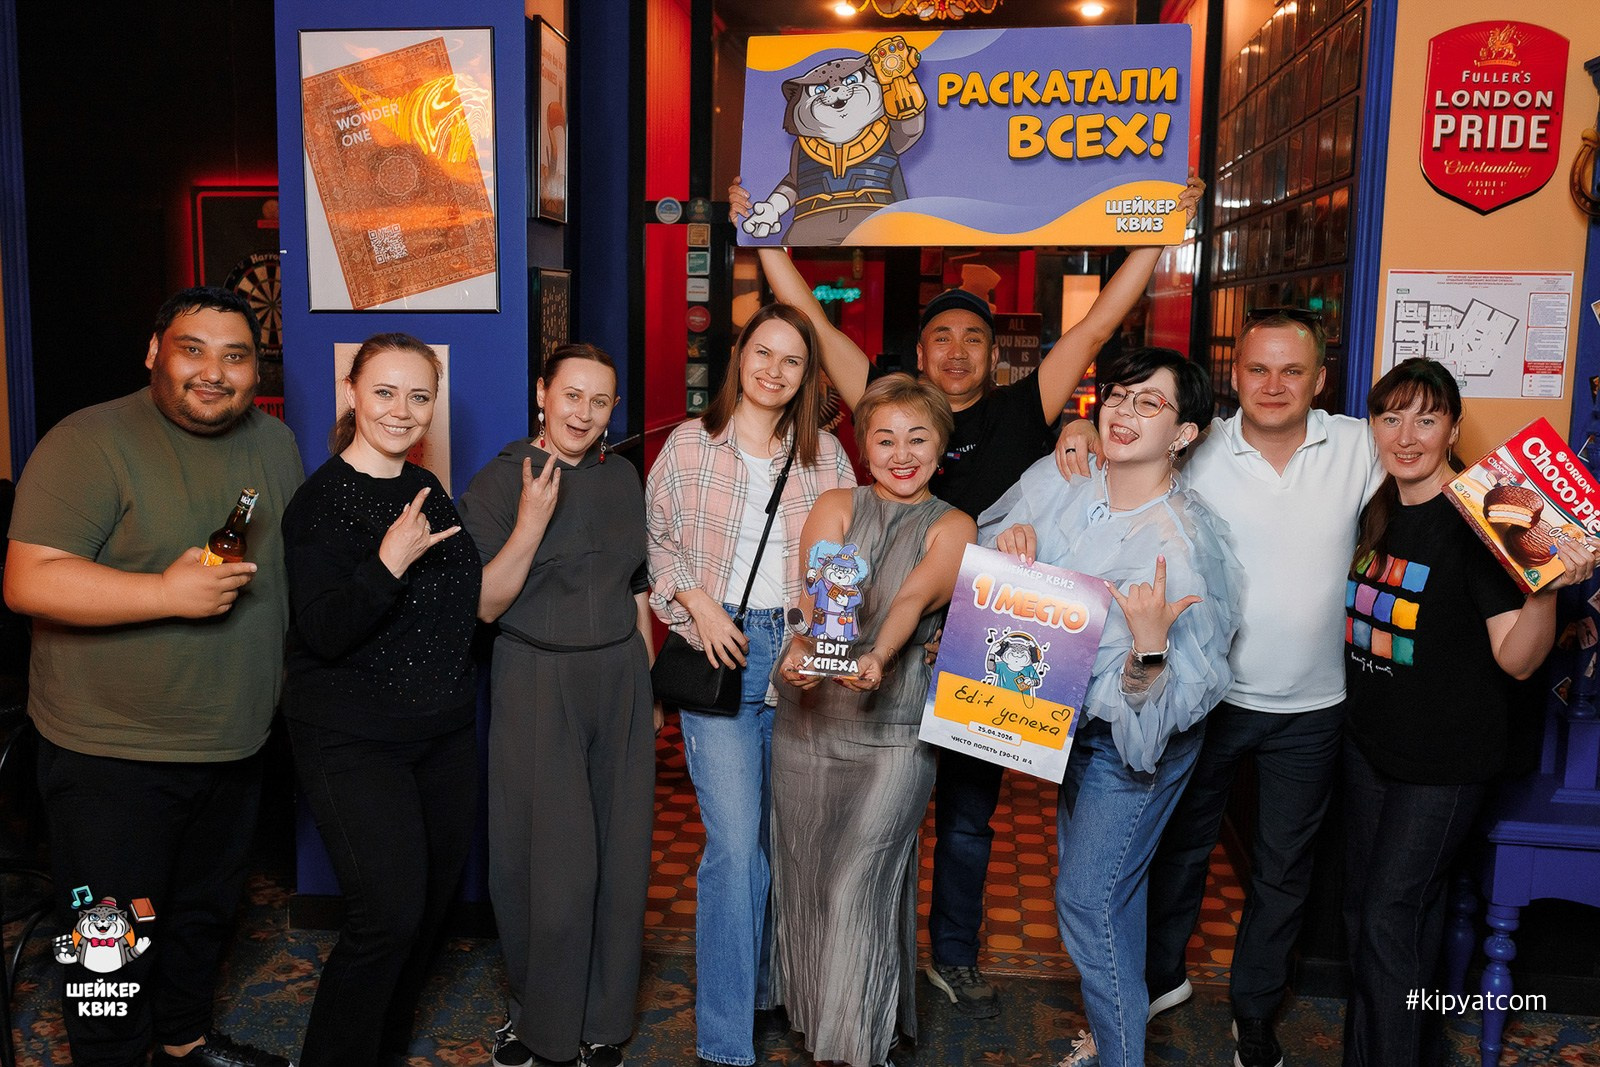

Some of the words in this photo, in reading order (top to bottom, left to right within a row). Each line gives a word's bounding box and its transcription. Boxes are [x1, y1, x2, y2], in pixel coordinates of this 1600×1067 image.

[1461, 70, 1532, 84] FULLER'S
[937, 67, 1178, 107] РАСКАТАЛИ
[1435, 90, 1553, 108] LONDON
[336, 103, 400, 131] WONDER
[341, 128, 372, 147] ONE
[1007, 112, 1172, 161] ВСЕХ!
[1432, 114, 1551, 150] PRIDE
[1444, 160, 1532, 178] Outstanding
[1105, 196, 1176, 216] ШЕЙКЕР
[1115, 215, 1164, 232] КВИЗ
[1008, 318, 1026, 331] ALL
[1014, 335, 1040, 348] NEED
[1021, 351, 1030, 362] IS
[1045, 574, 1075, 590] КВИЗ
[974, 574, 994, 607] 1
[993, 585, 1089, 632] МЕСТО
[816, 641, 849, 656] EDIT
[802, 655, 859, 673] УСПЕХА
[954, 685, 994, 707] Edit
[992, 707, 1061, 736] успеха
[977, 725, 1013, 741] 25.04.2026
[950, 735, 972, 746] ЧИСТО
[973, 742, 998, 754] ПОПЕТЬ
